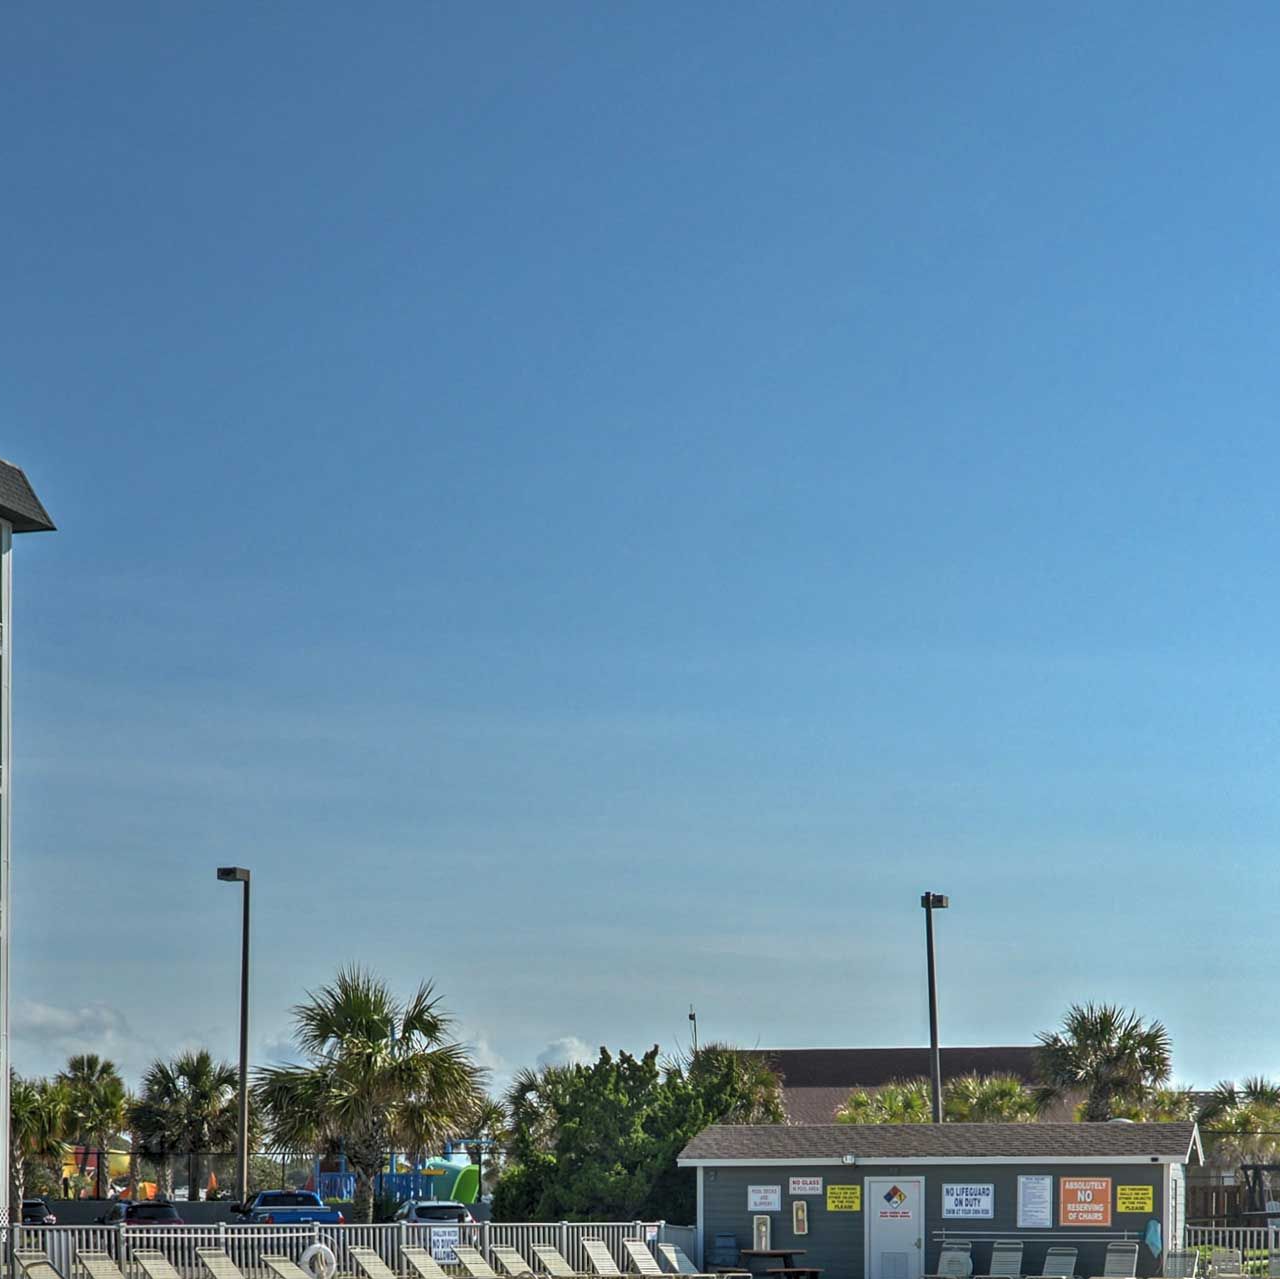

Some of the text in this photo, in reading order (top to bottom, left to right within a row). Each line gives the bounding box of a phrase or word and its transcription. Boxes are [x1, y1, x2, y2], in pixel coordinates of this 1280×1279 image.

[1065, 1181, 1107, 1189] ABSOLUTELY
[945, 1187, 990, 1196] NO LIFEGUARD
[1077, 1190, 1093, 1202] NO
[954, 1197, 981, 1207] ON DUTY
[1067, 1203, 1104, 1211] RESERVING
[1068, 1212, 1104, 1220] OF CHAIRS
[433, 1239, 440, 1248] NO
